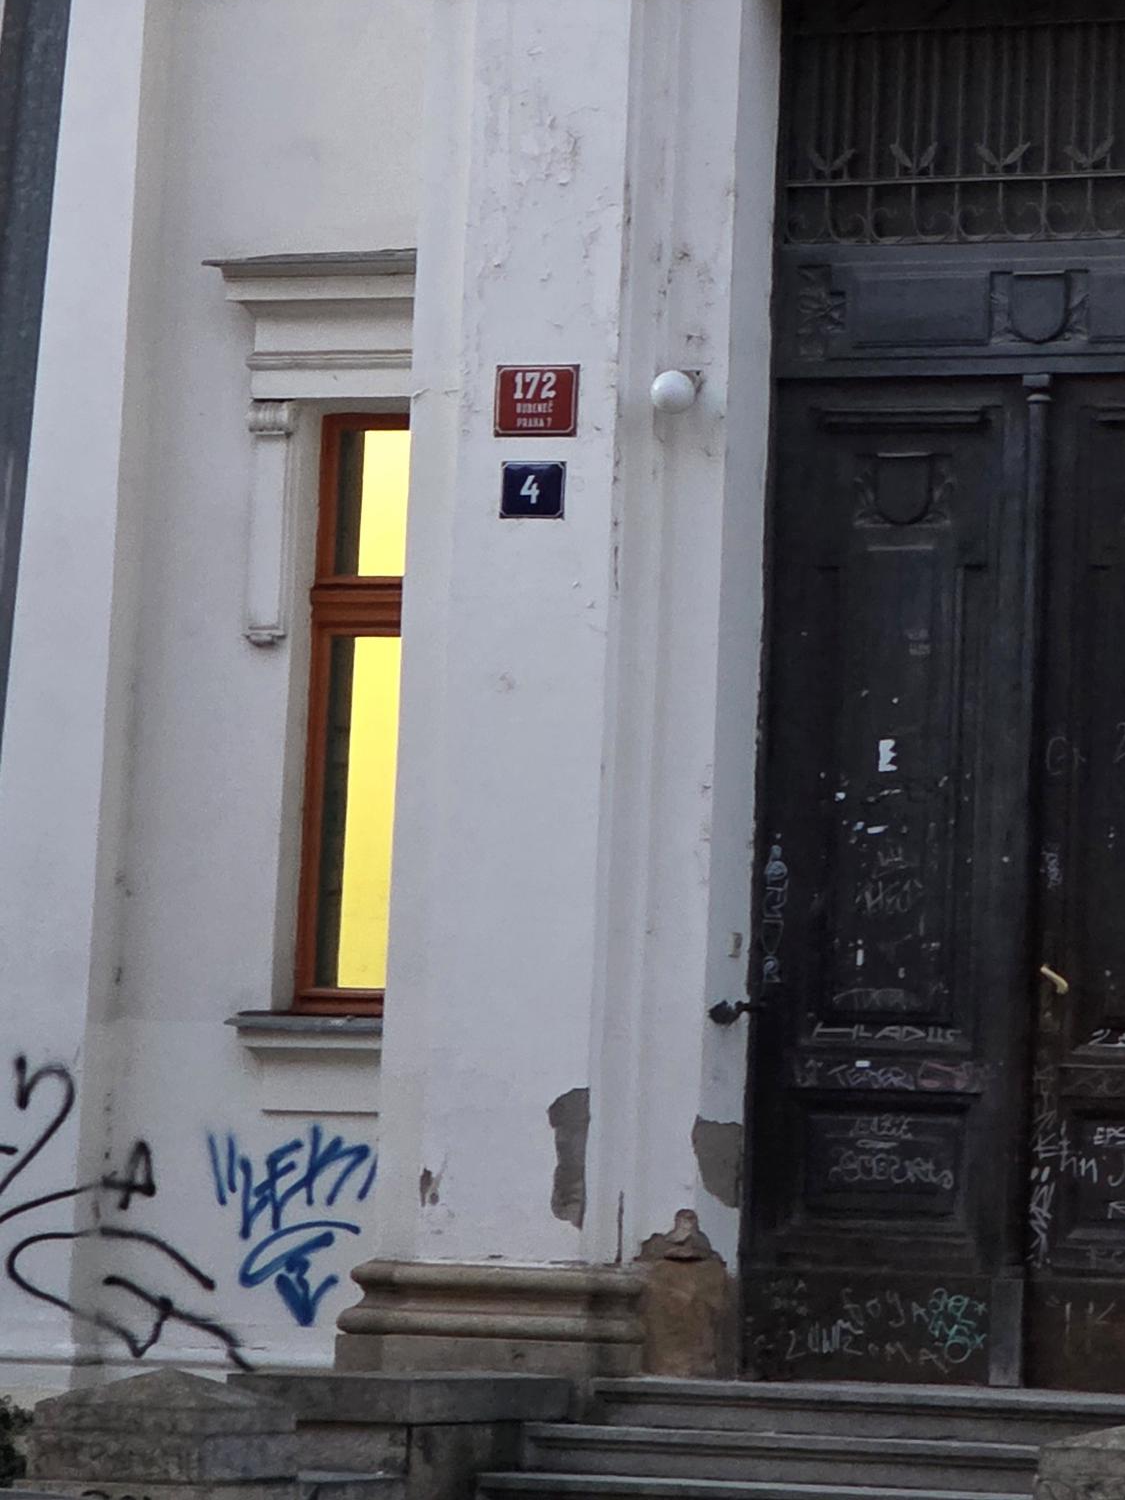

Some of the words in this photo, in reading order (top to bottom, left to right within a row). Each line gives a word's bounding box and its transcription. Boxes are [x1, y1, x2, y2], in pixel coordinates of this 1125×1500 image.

[513, 372, 557, 400] 172
[516, 417, 545, 428] PRAHA
[546, 417, 553, 428] 7
[519, 474, 540, 504] 4
